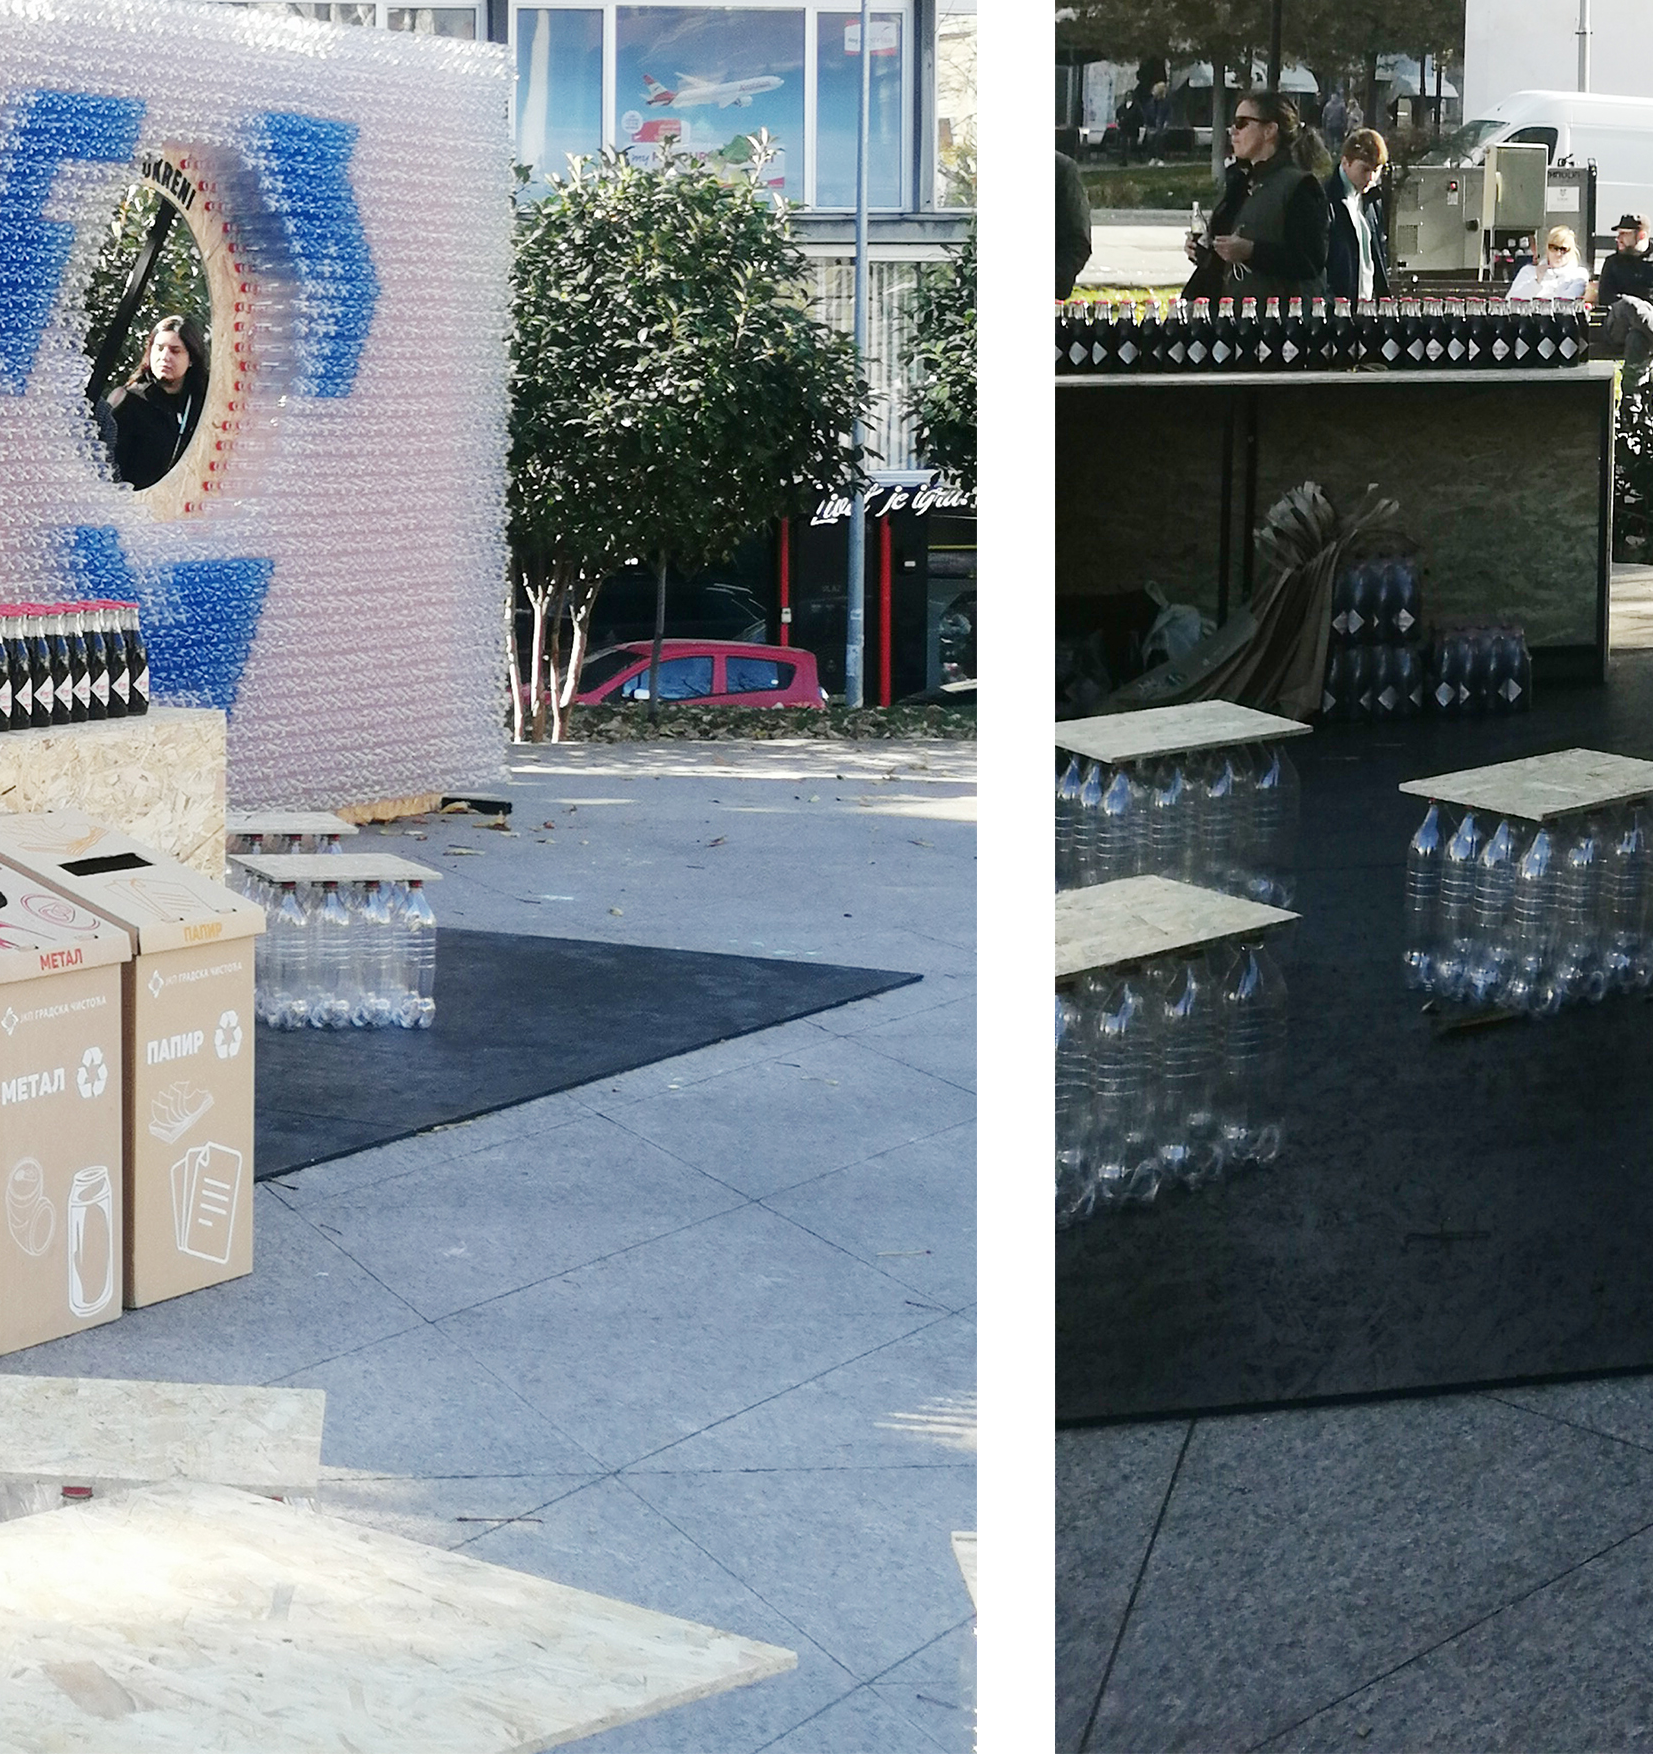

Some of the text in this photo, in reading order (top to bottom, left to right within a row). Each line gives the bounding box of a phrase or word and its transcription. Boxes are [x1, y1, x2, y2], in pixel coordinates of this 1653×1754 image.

[874, 485, 910, 518] je
[183, 921, 223, 943] ПАПИР
[39, 948, 84, 971] МЕТАЛ
[34, 1003, 70, 1020] ГРАДСКА
[147, 1029, 205, 1066] ПАПИР
[1, 1067, 66, 1106] МЕТАЛ
